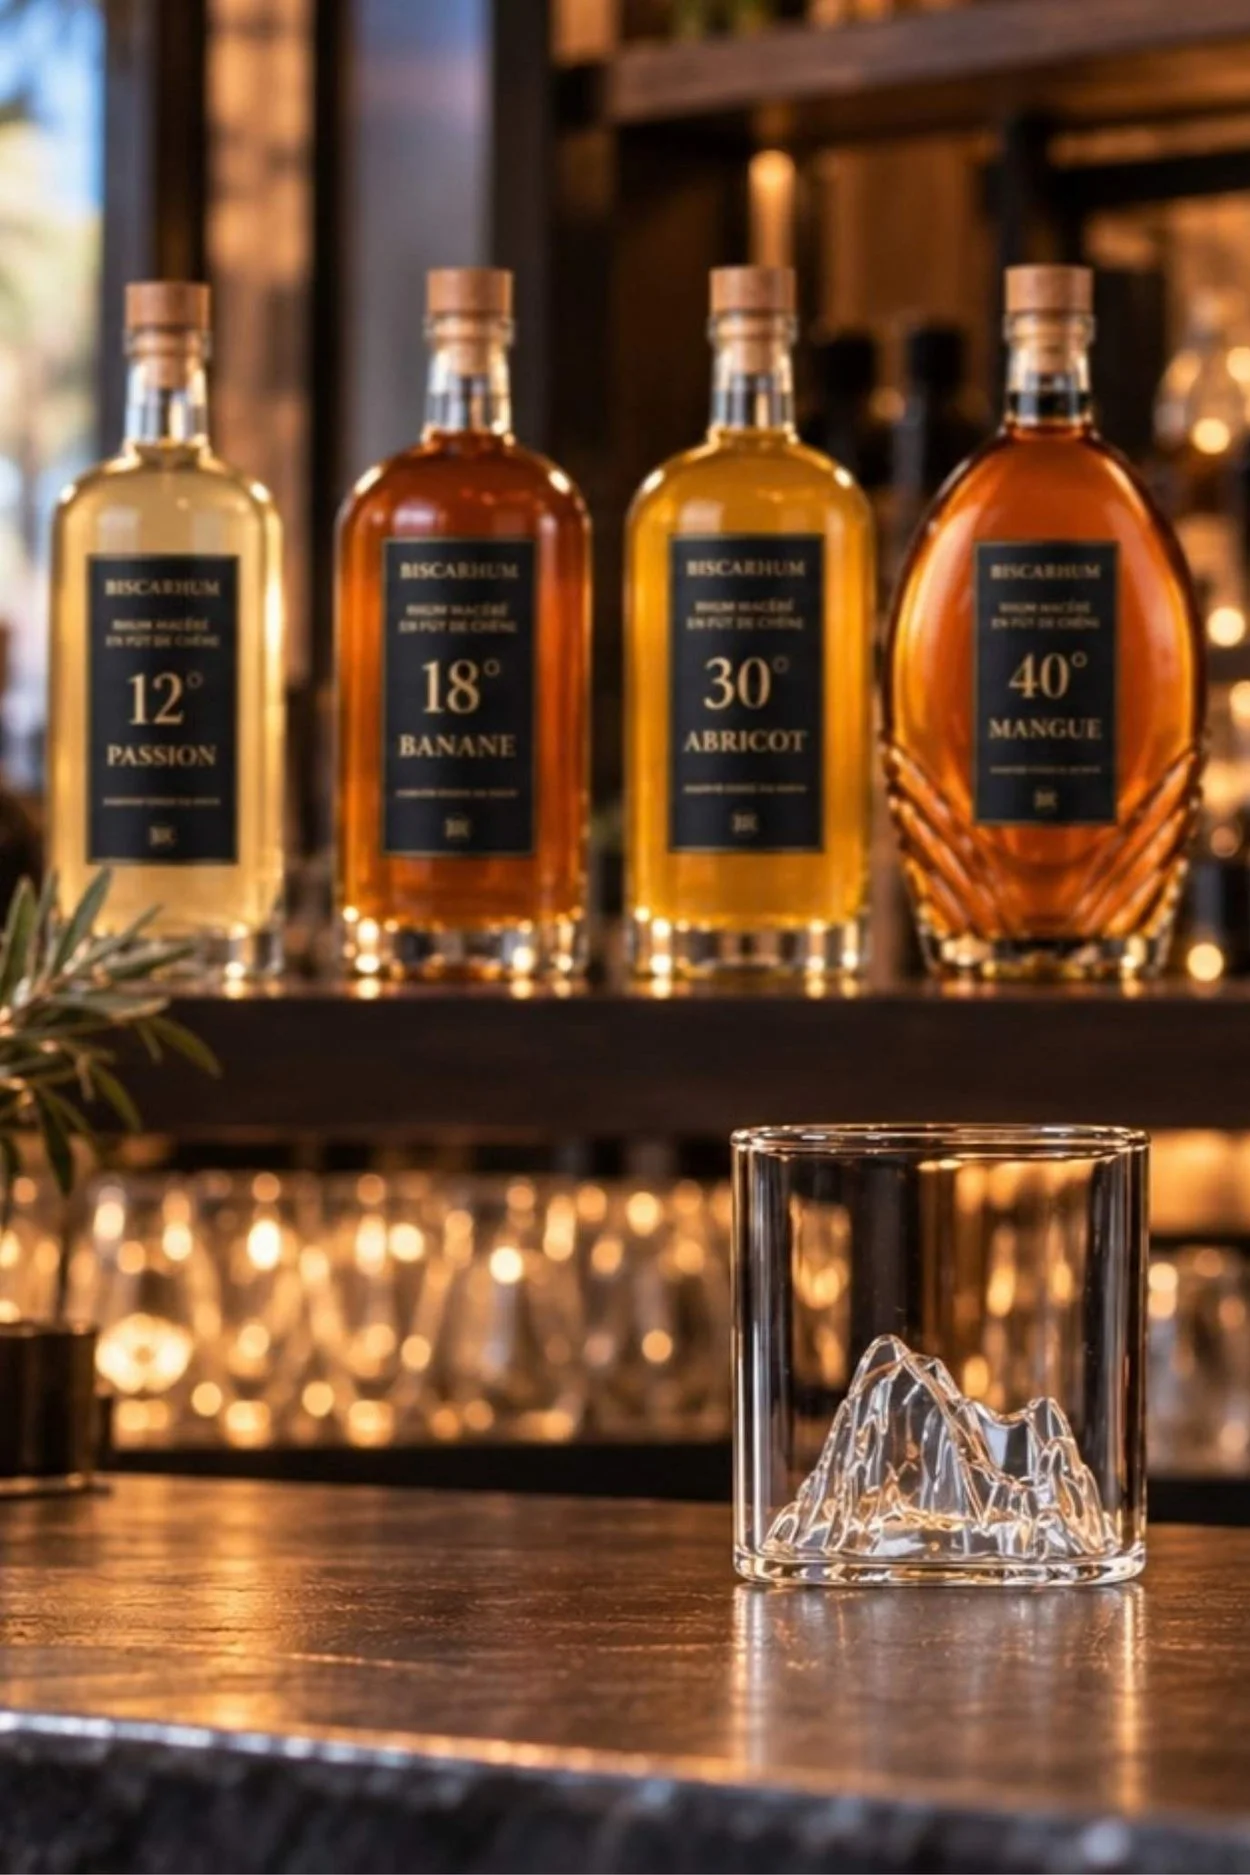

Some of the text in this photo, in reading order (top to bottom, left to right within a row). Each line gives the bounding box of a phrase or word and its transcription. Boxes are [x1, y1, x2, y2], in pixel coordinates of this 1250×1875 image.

[399, 562, 519, 579] BISCARHUM
[686, 560, 806, 576] BISCARHUM
[990, 564, 1101, 580] BISCARHUM
[105, 579, 220, 596] BISCARHUM
[988, 718, 1102, 739] MANGUE
[400, 735, 515, 757] BANANE
[684, 730, 806, 752] ABRICOT
[107, 745, 217, 767] PASSION
